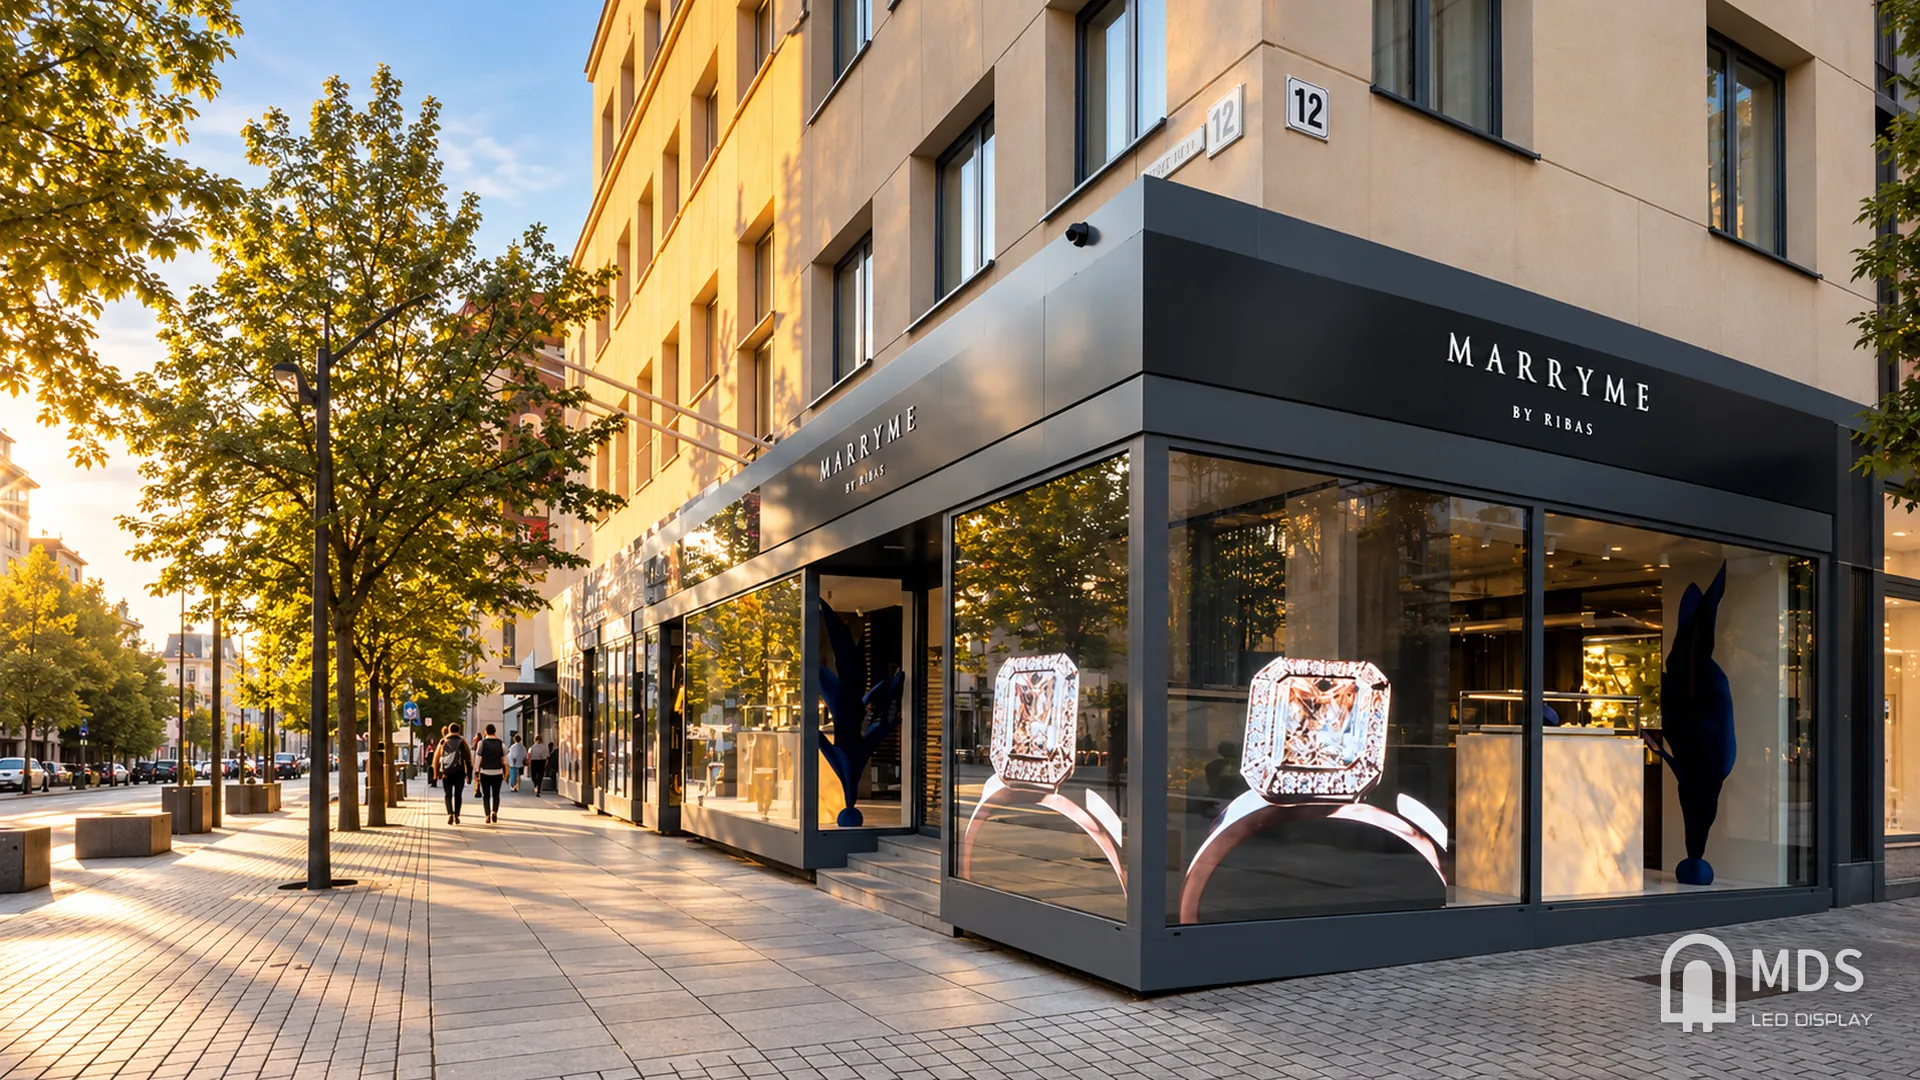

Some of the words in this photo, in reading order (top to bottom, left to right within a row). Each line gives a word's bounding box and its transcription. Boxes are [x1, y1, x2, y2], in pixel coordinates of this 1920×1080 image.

[1212, 99, 1235, 144] 12
[1294, 87, 1323, 130] 12
[1446, 331, 1650, 412] MARRYME
[1512, 405, 1533, 422] BY
[1544, 412, 1594, 436] RIBAS
[819, 405, 917, 483] MARRYME
[859, 464, 886, 487] RIBAS
